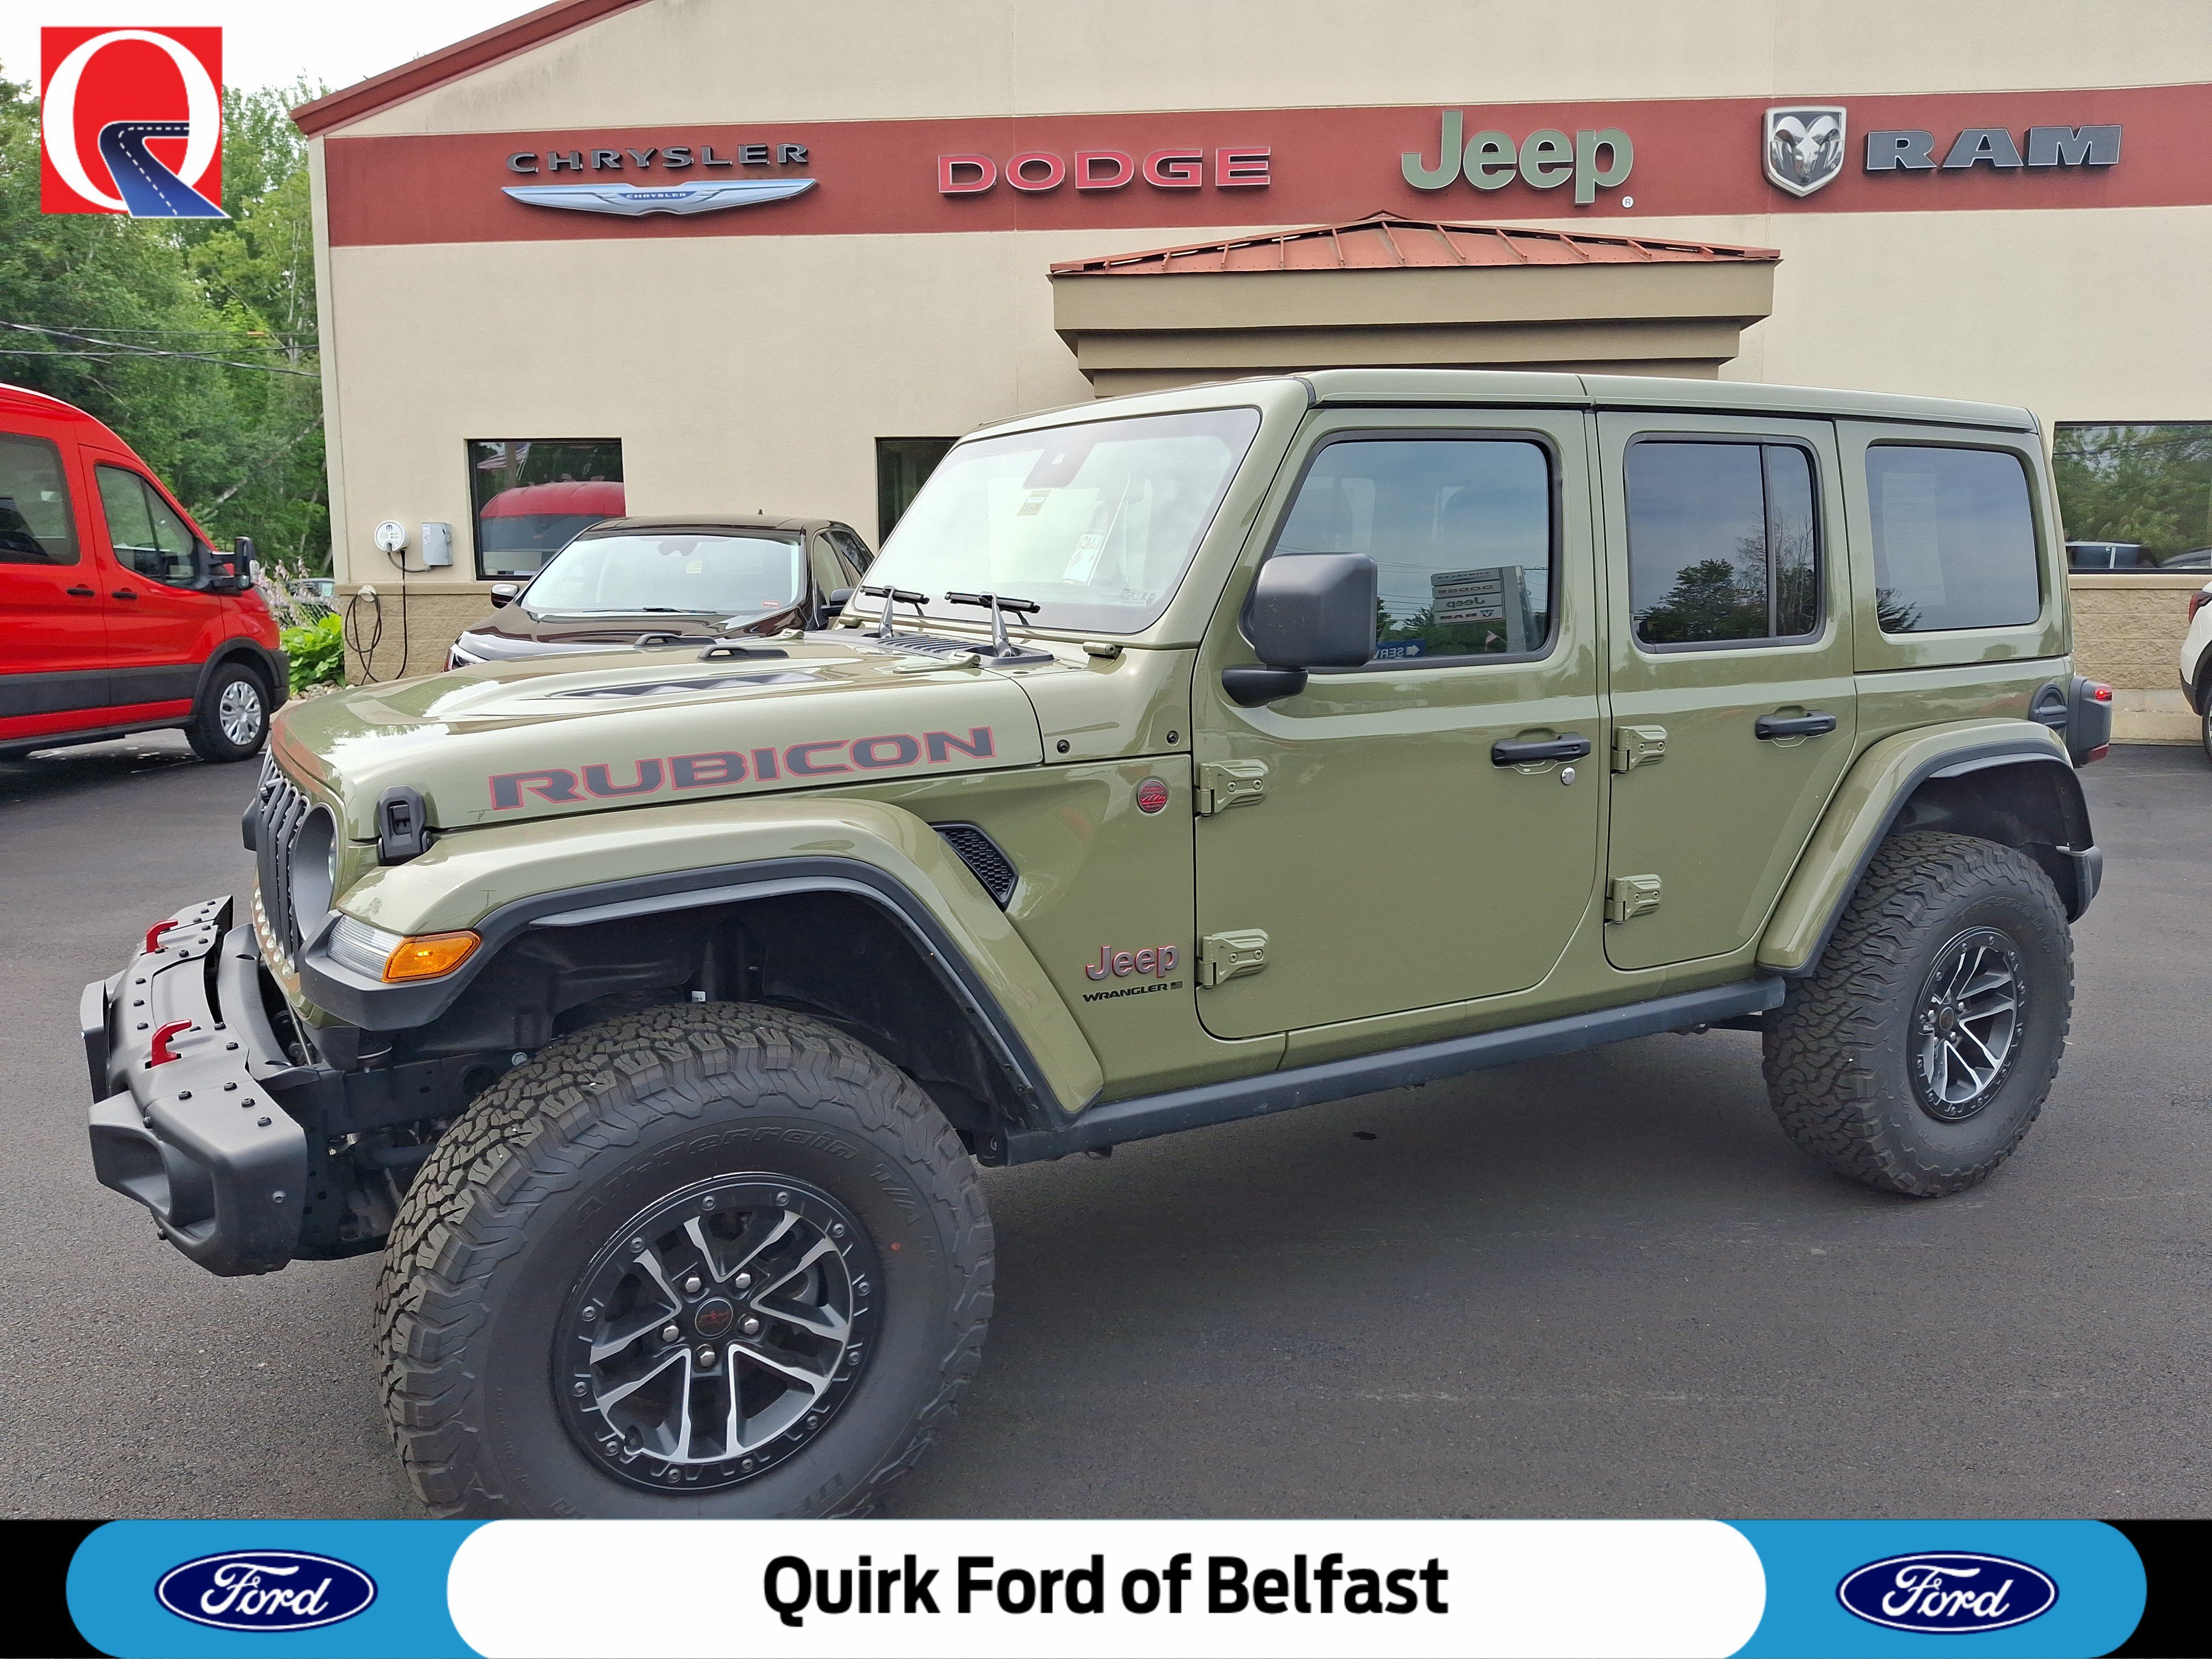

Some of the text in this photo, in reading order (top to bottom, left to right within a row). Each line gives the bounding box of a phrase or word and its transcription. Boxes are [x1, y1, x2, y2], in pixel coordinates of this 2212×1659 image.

[506, 143, 810, 173] CHRYSLER
[937, 146, 1272, 194] DODGE
[1401, 110, 1634, 206] Jeep
[1864, 124, 2123, 171] RAM
[488, 725, 997, 811] RUBICON
[1085, 944, 1179, 981] Jeep
[1082, 982, 1168, 1002] WRANGLER
